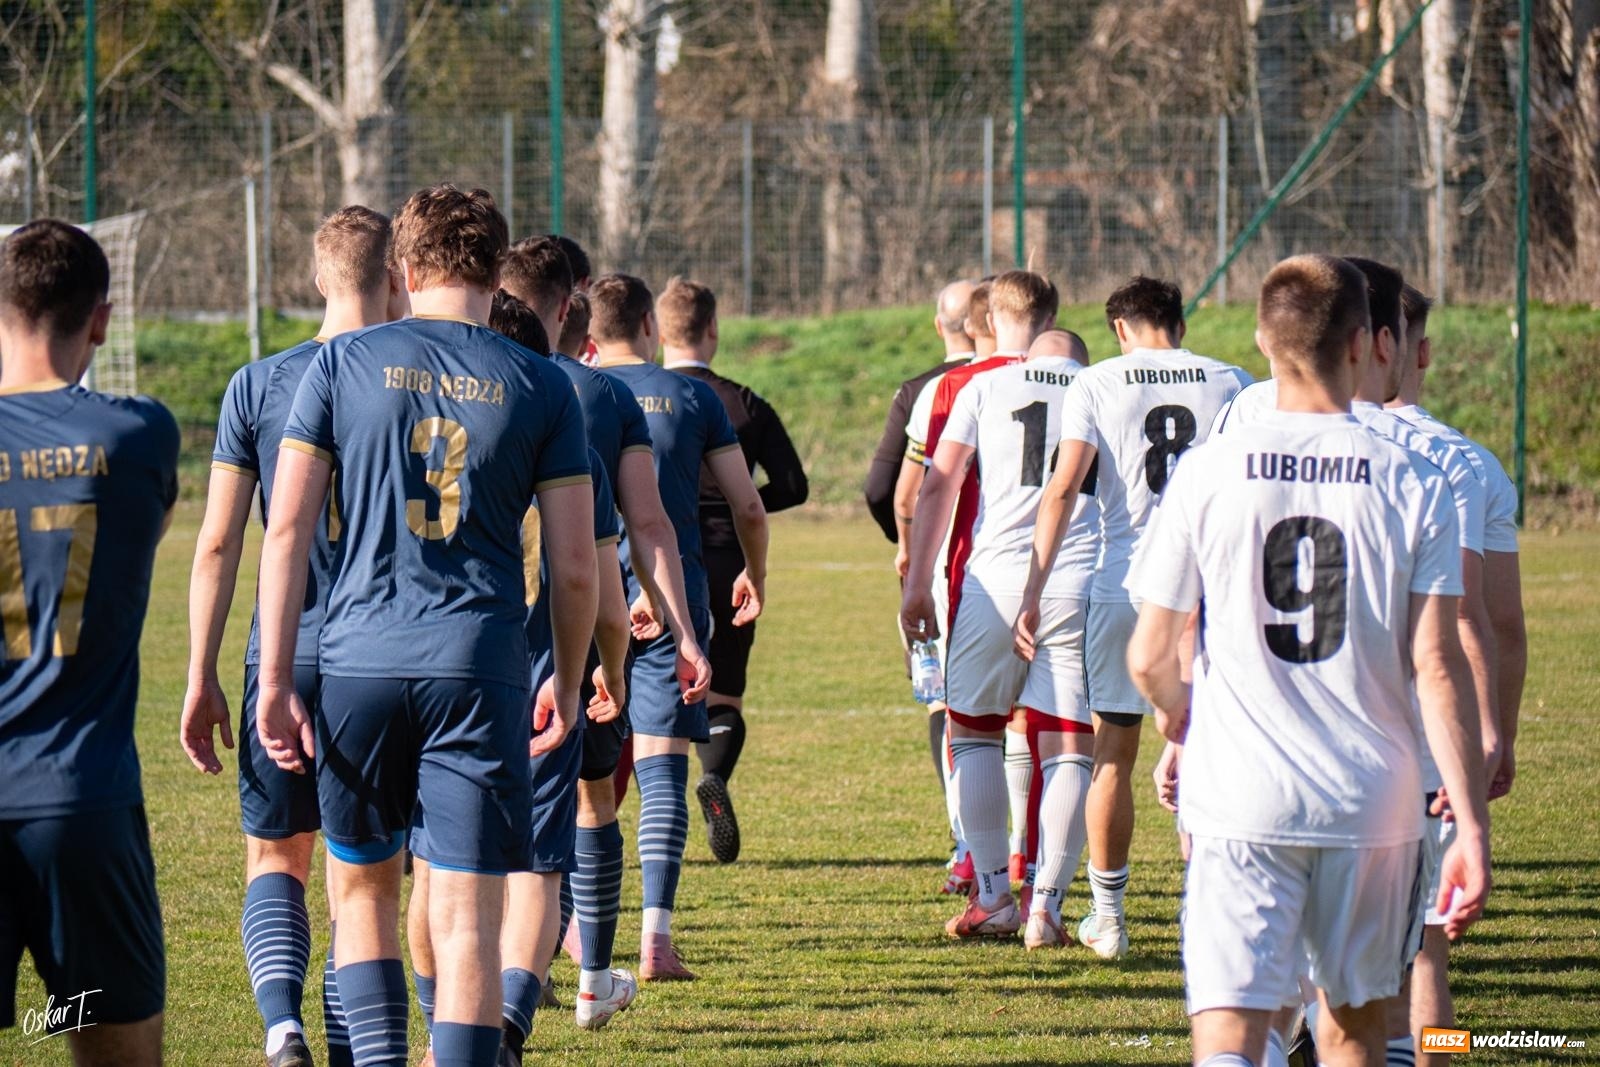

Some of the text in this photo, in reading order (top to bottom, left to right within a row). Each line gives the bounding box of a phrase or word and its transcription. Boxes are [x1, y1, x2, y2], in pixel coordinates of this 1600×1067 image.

[383, 366, 504, 405] 1908 NĘDZA
[1025, 369, 1074, 387] LUBO
[1125, 367, 1207, 385] LUBOMIA
[20, 444, 109, 482] NĘDZA
[1144, 404, 1197, 495] 8
[1246, 452, 1371, 486] LUBOMIA
[405, 416, 468, 541] 3
[0, 503, 98, 660] 17
[1262, 515, 1348, 664] 9
